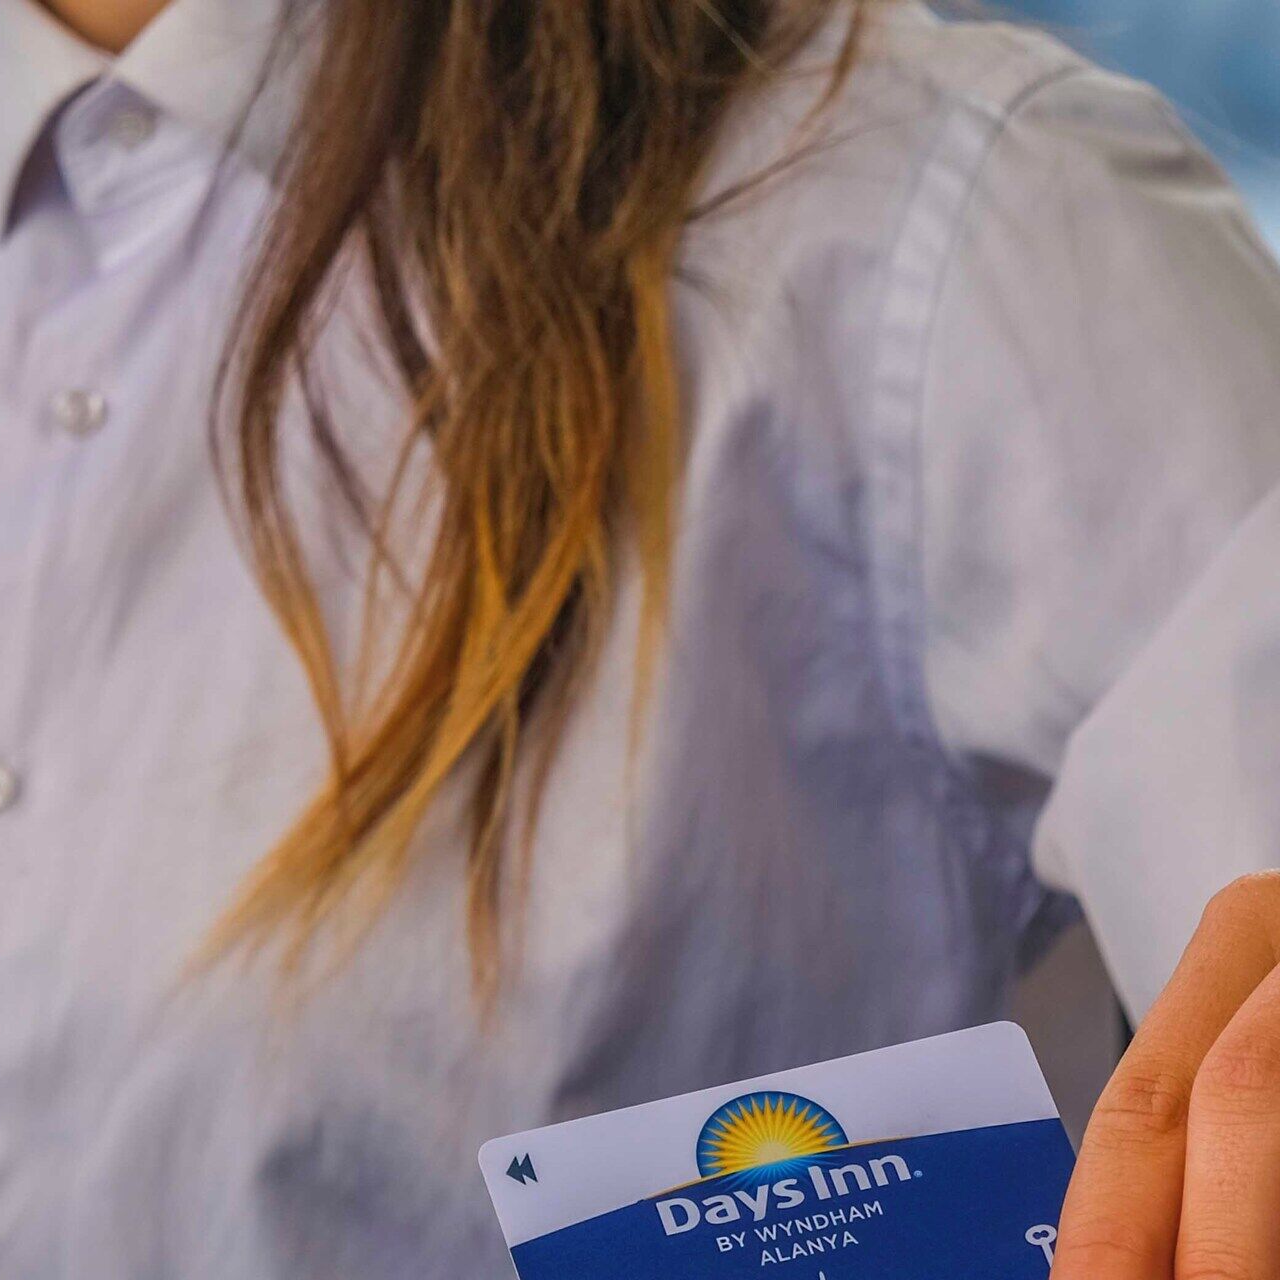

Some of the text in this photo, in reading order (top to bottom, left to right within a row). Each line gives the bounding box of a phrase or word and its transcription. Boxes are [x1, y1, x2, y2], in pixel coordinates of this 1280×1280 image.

[655, 1154, 912, 1236] Days Inn
[715, 1200, 884, 1252] BY WYNDHAM
[760, 1230, 859, 1267] ALANYA
